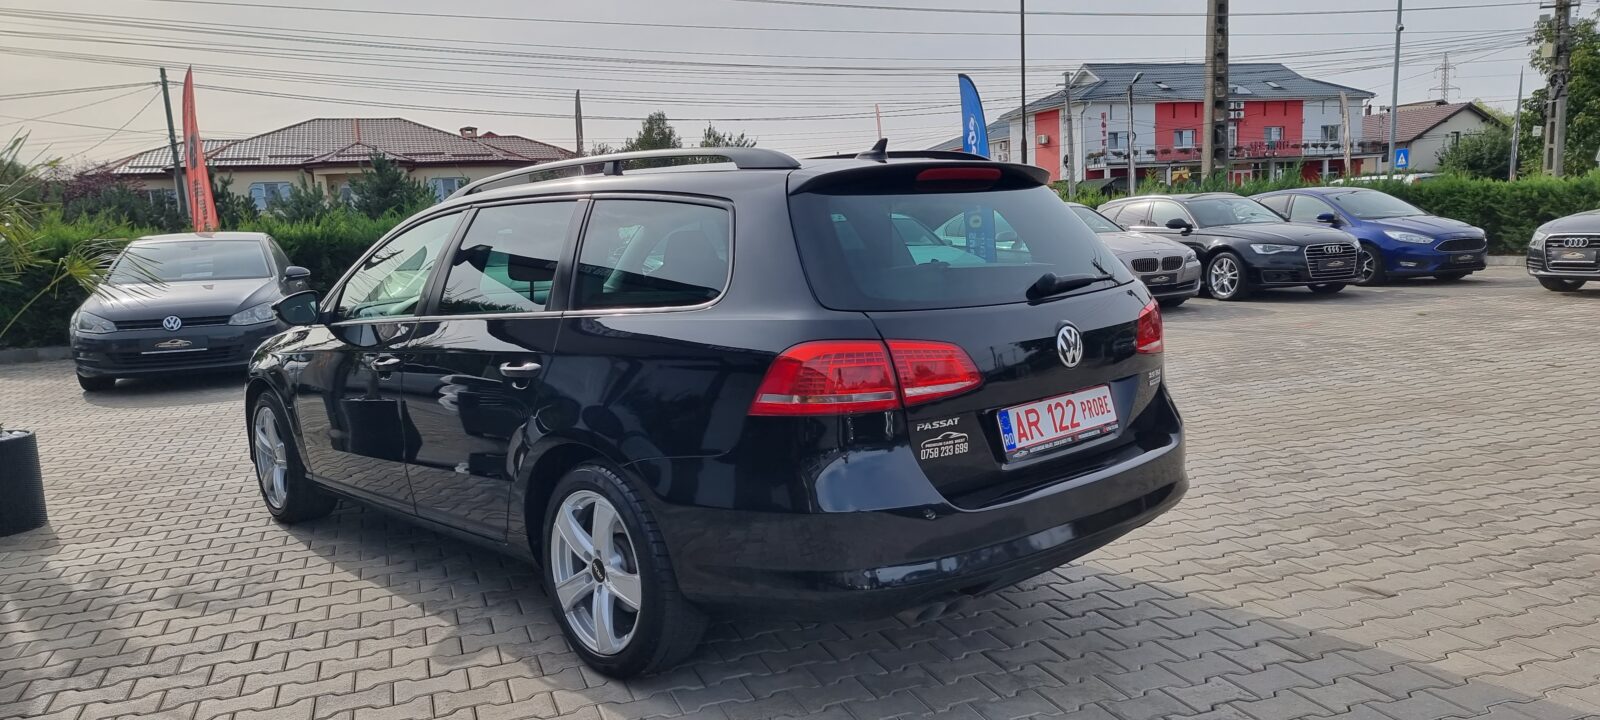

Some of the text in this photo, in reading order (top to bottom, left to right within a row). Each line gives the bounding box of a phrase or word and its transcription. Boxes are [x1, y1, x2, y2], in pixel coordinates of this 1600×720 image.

[916, 417, 960, 431] PASSAT
[1015, 395, 1111, 443] AR 122 PROBE
[1004, 432, 1015, 446] RO
[920, 442, 968, 460] 0758 233 699
